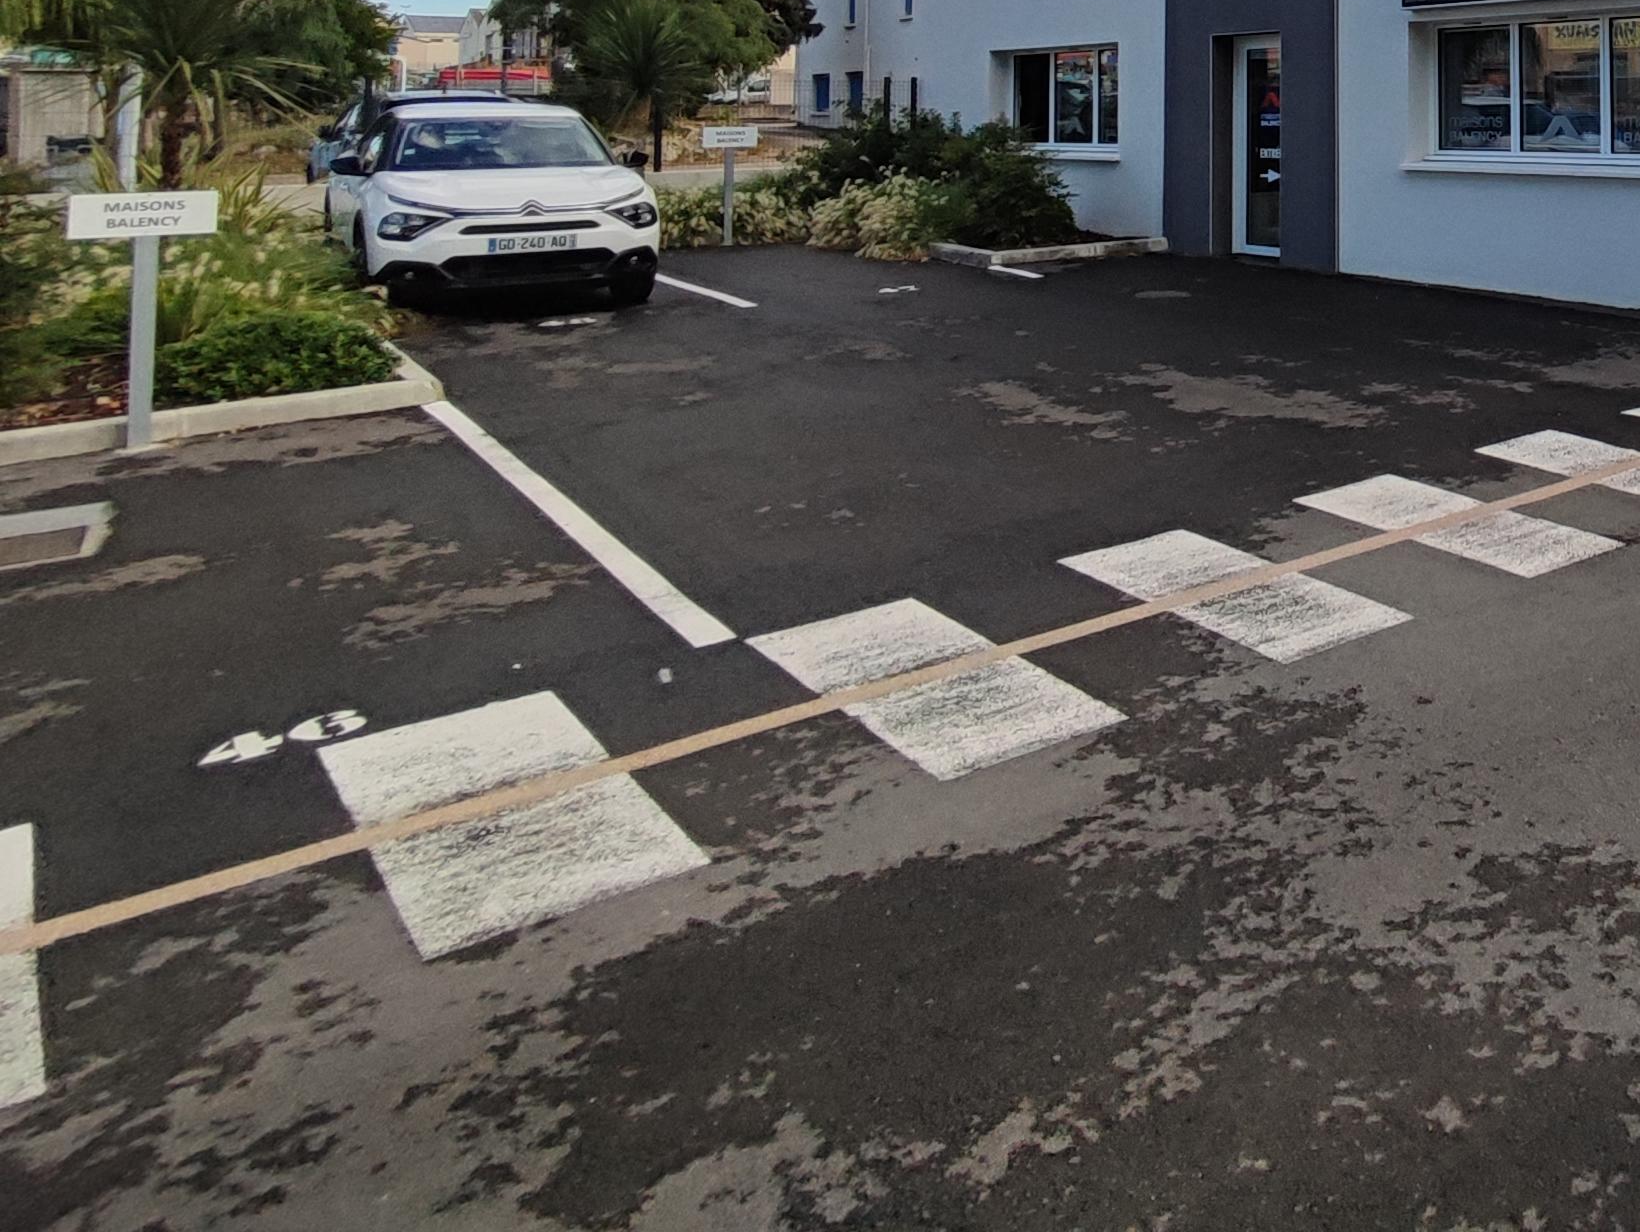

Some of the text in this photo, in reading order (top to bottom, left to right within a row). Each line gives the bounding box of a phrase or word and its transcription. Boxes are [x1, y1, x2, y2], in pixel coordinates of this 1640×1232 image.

[1449, 115, 1504, 129] maisons
[103, 199, 186, 213] MAISONS
[106, 215, 182, 229] BALENCY
